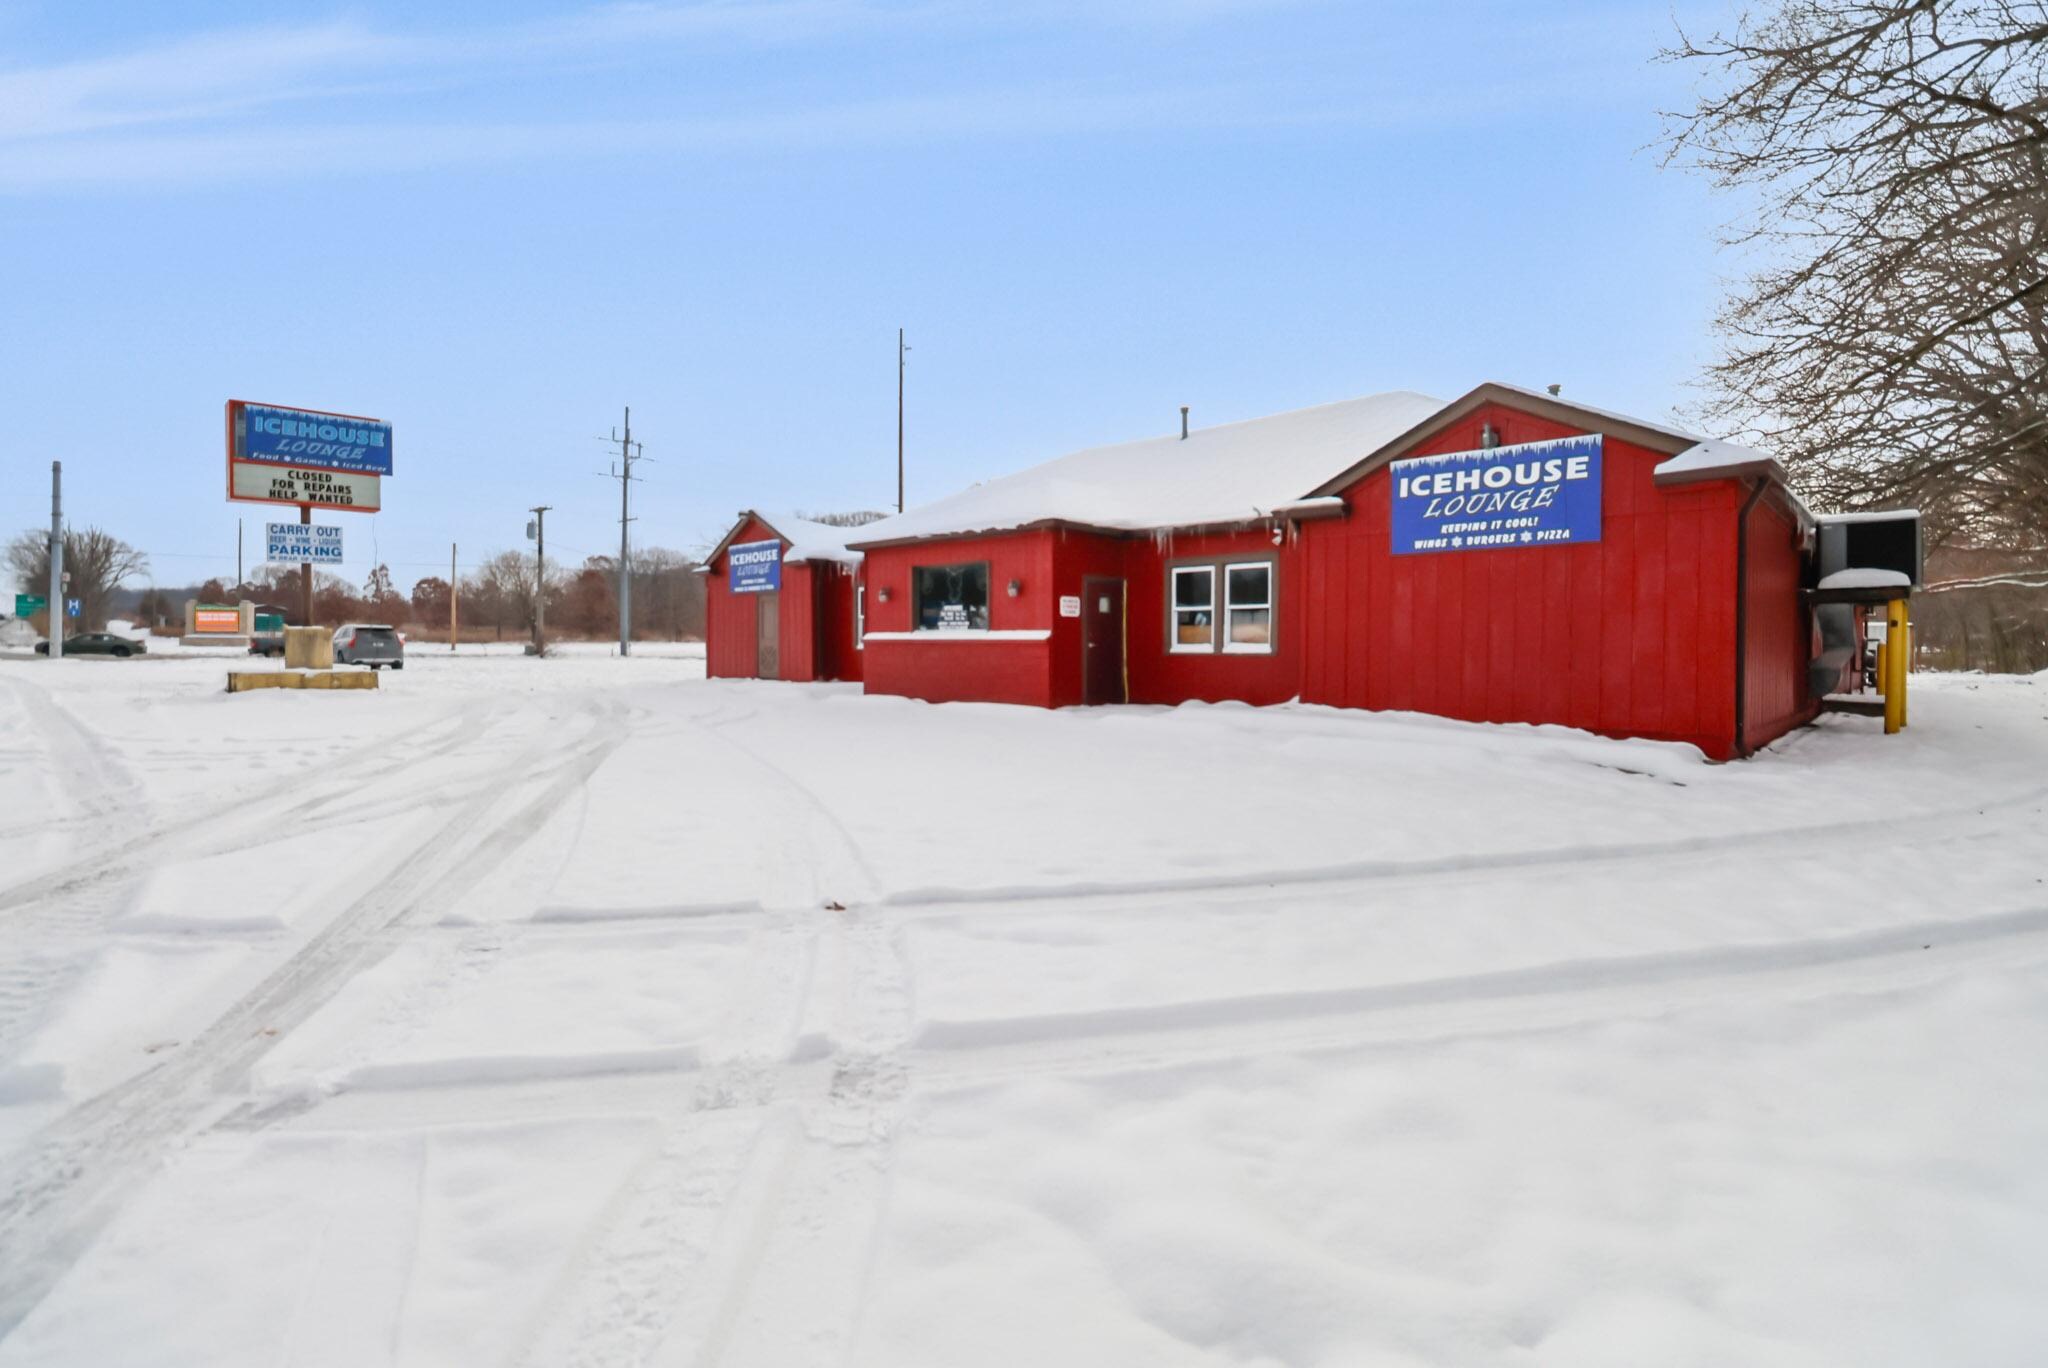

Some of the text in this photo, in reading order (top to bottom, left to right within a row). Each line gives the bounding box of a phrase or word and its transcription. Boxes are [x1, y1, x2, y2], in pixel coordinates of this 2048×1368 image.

[255, 416, 385, 447] ICEHOUSE
[276, 439, 366, 460] LOUNGE
[252, 452, 279, 461] Food
[295, 457, 327, 466] Games
[288, 470, 332, 482] CLOSED
[1399, 456, 1589, 498] ICEHOUSE
[272, 479, 352, 495] FOR REPAIRS
[269, 489, 353, 505] HELP WANTED
[1423, 484, 1560, 518] LOUNGE
[270, 524, 340, 537] CARRY OUT
[1440, 517, 1539, 534] KEEPING IT COOL!
[1414, 529, 1570, 550] WINGS BURGERS PIZZA
[269, 544, 342, 557] PARKING
[730, 549, 778, 566] ICEHOUSE
[69, 600, 79, 610] H
